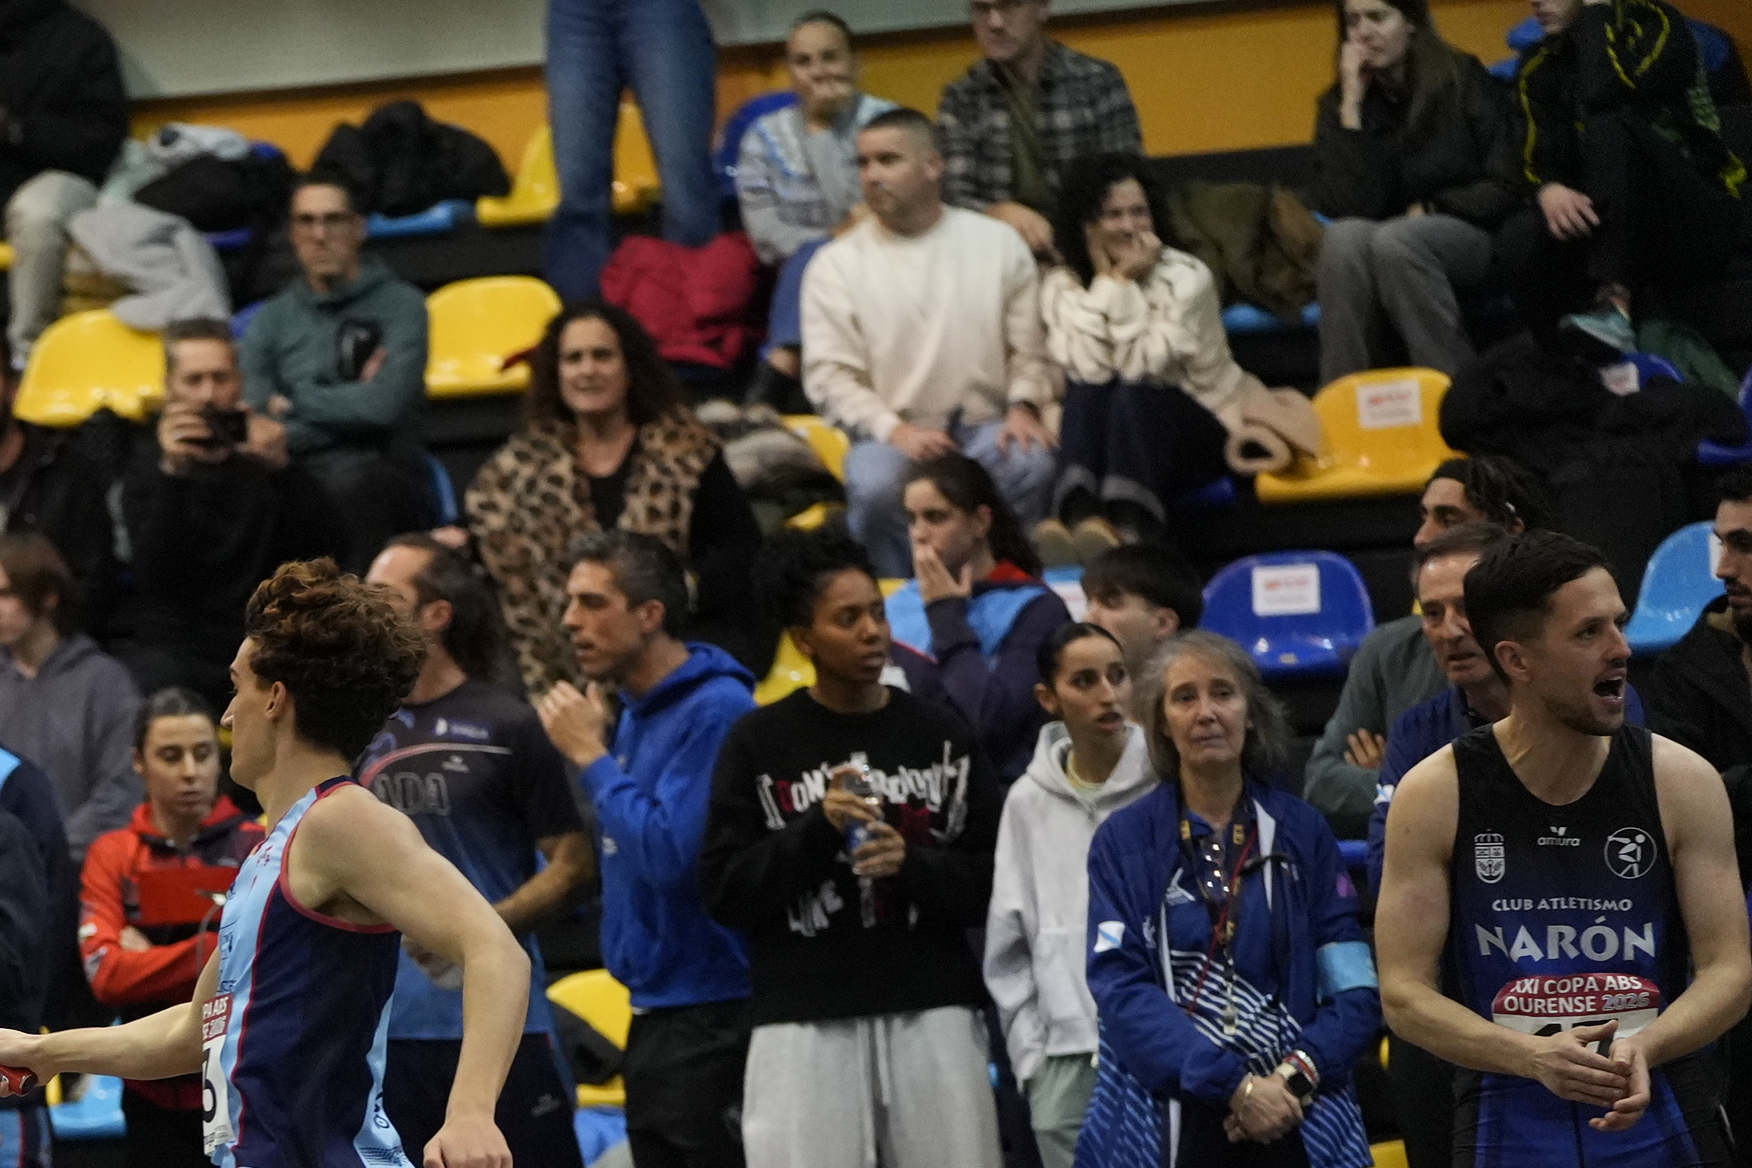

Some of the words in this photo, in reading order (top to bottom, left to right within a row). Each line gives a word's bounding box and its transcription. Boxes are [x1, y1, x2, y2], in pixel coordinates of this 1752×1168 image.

[1537, 836, 1581, 847] amura
[1492, 898, 1534, 912] CLUB
[1537, 896, 1633, 912] ATLETISMO
[1474, 915, 1656, 963] NARÓN
[1543, 976, 1599, 995] COPA
[1604, 975, 1643, 991] ABS
[1503, 995, 1597, 1014] OURENSE
[1601, 992, 1650, 1012] 2026
